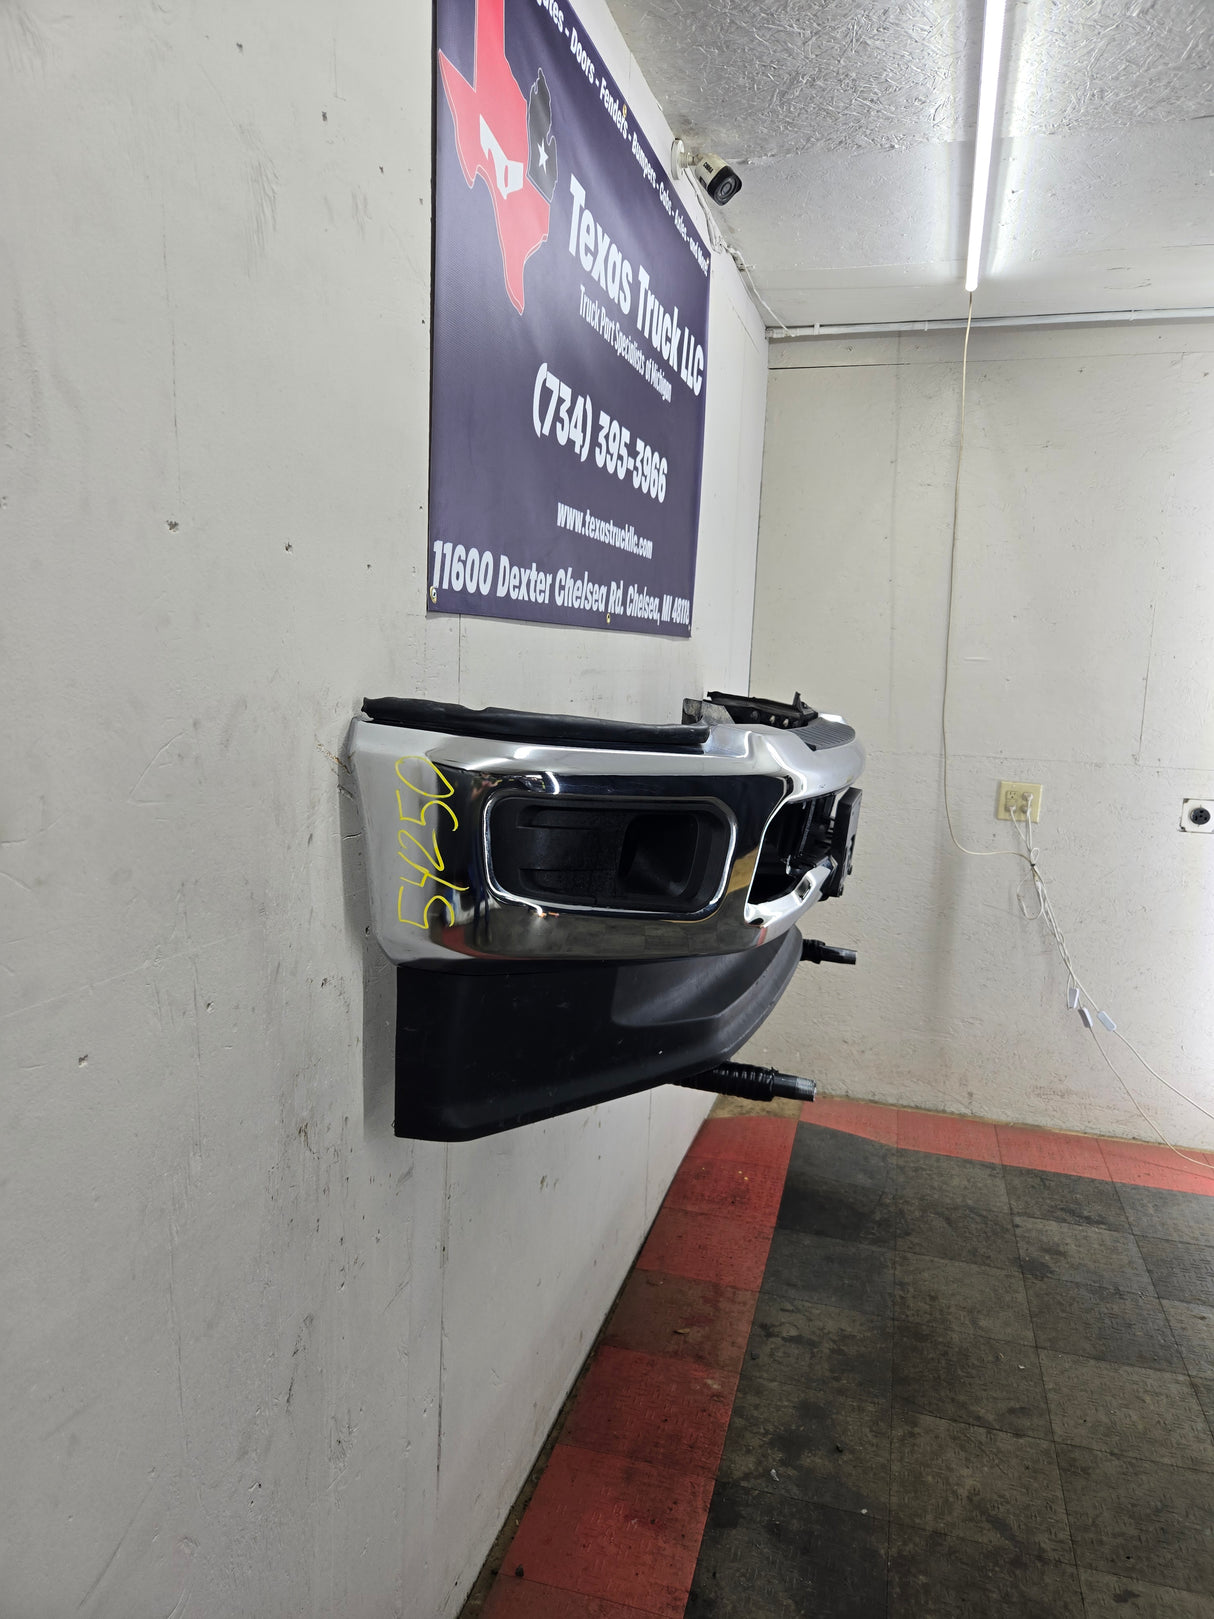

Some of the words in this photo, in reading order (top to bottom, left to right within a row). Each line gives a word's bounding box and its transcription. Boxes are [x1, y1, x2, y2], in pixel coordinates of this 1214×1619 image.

[537, 0, 564, 32] tes
[570, 27, 595, 84] Doors
[599, 77, 628, 140] Fenders
[632, 131, 657, 189] Bumpers
[659, 181, 673, 215] Cabs
[569, 174, 633, 315] Texas
[637, 265, 682, 372] Truck
[680, 327, 704, 396] LLC
[579, 284, 601, 332] Truck
[600, 306, 615, 346] Part
[614, 322, 645, 376] Specialists
[645, 358, 652, 382] of
[651, 360, 672, 403] Michigan
[532, 362, 593, 462] (734)
[595, 411, 668, 503] 395-3966
[433, 540, 494, 596] 11600
[496, 554, 553, 604] Dexter
[555, 566, 608, 613] Chelsea
[607, 580, 624, 615] Rd.
[626, 584, 660, 626] Chelsea,
[661, 594, 673, 622] MI
[672, 597, 690, 625] 48118
[556, 502, 653, 559] www.texastruckllc.com
[395, 755, 470, 930] 54250
